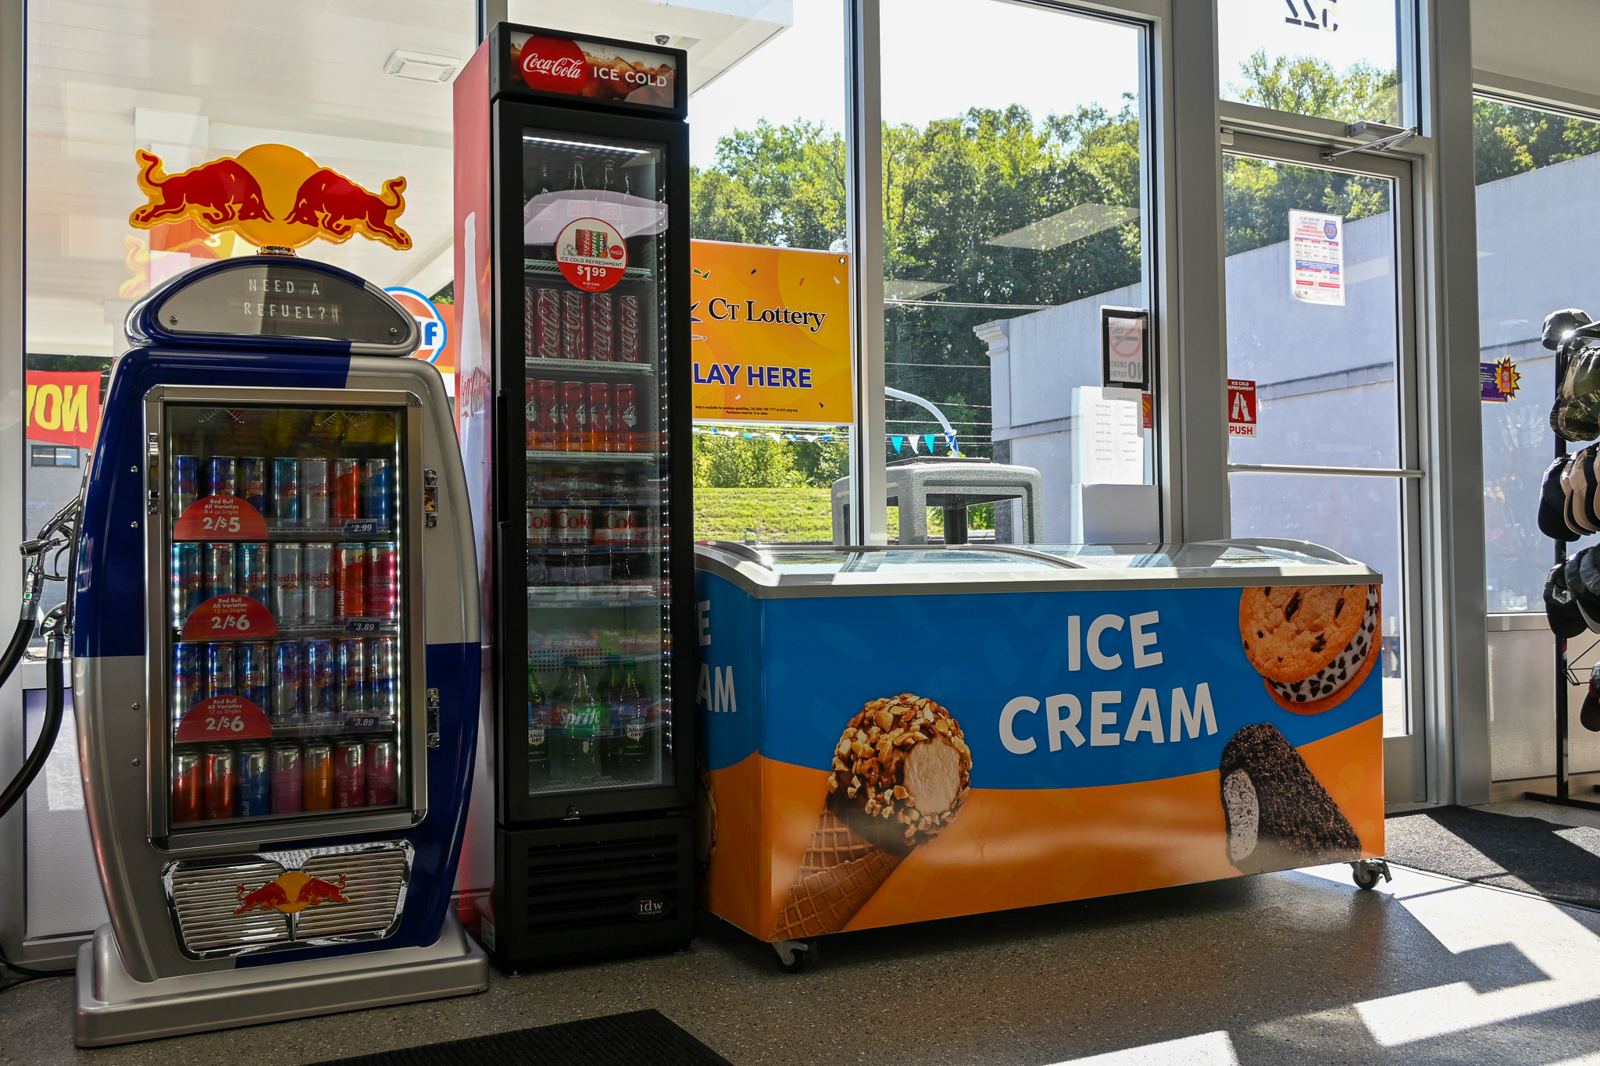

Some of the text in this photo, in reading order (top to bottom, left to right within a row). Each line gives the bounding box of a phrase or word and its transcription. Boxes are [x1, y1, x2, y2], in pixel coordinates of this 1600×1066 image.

[523, 52, 584, 79] Coca-Cola
[593, 66, 667, 87] ICE COLD
[249, 278, 320, 295] NEED A
[244, 302, 325, 320] REFUEL?
[745, 300, 826, 332] Lottery
[694, 363, 812, 388] LAY HERE
[1229, 426, 1253, 435] PUSH
[202, 515, 241, 533] 2/$5
[210, 614, 251, 631] 2/$6
[1066, 610, 1164, 672] ICE
[204, 715, 245, 732] 2/$6
[560, 707, 602, 729] Sprite
[998, 681, 1219, 756] CREAM
